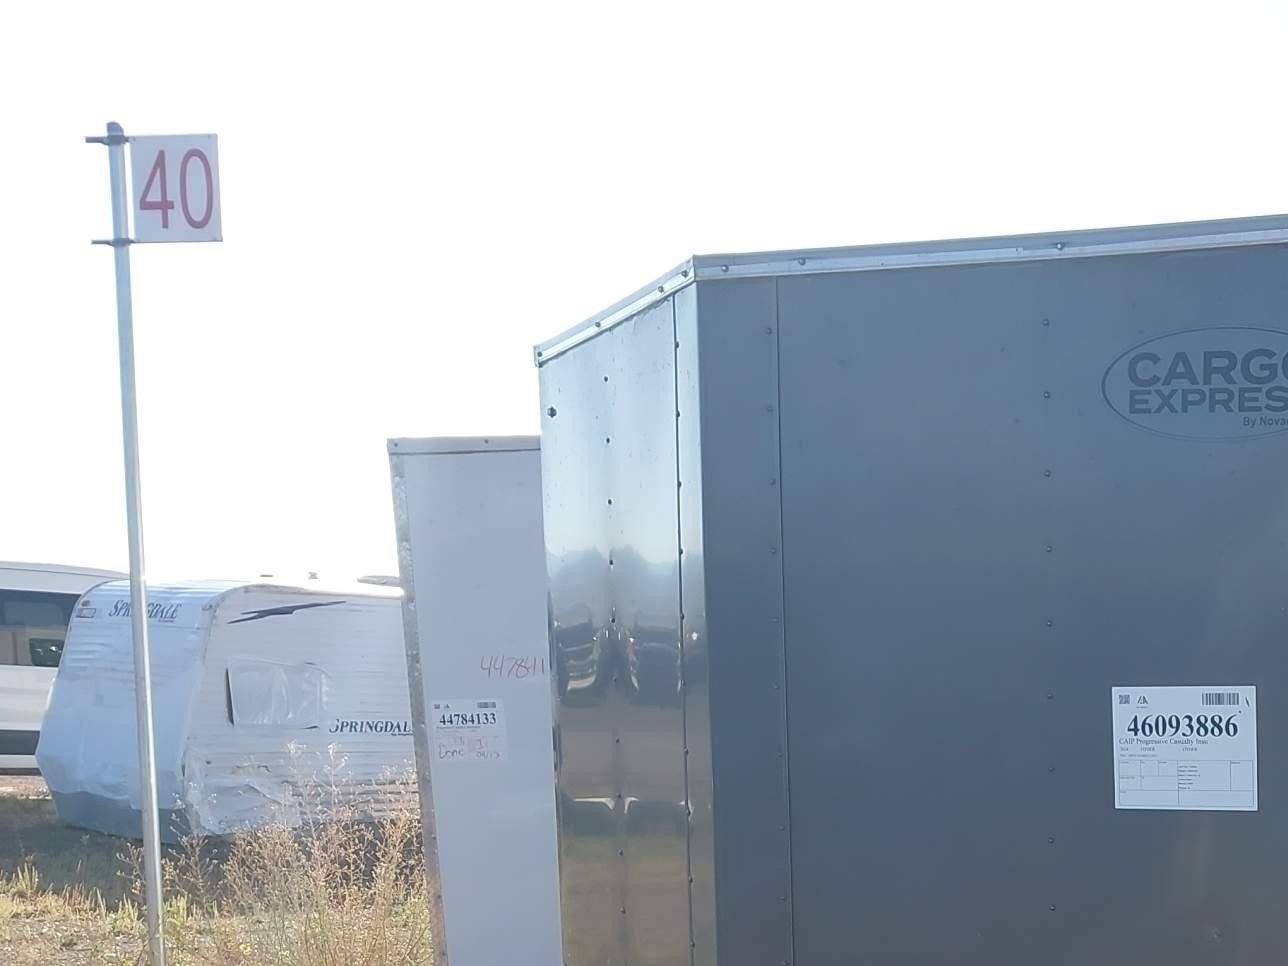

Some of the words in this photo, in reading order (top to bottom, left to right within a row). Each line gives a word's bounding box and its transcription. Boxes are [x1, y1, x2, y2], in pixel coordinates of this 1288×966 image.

[140, 148, 213, 229] 40
[1242, 416, 1257, 427] By
[329, 718, 412, 733] SPRINGDAL
[439, 712, 497, 726] 44784133
[1127, 714, 1239, 738] 46093886
